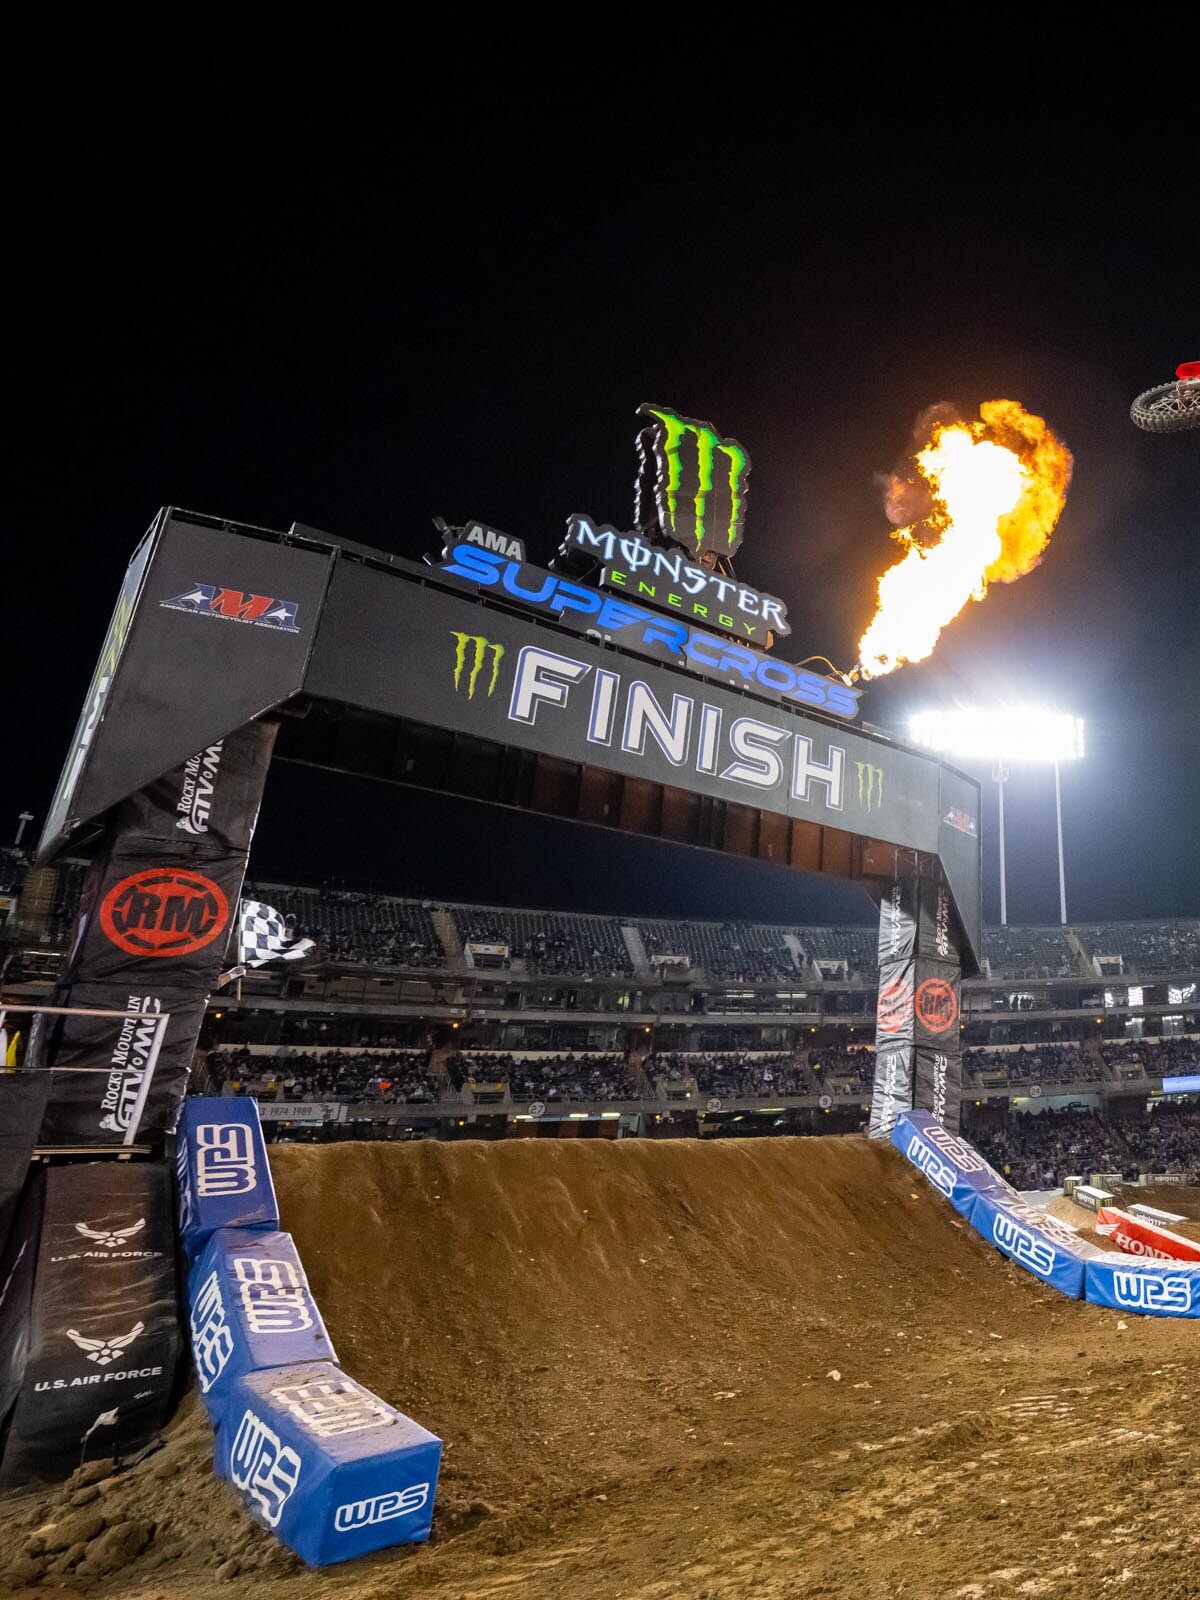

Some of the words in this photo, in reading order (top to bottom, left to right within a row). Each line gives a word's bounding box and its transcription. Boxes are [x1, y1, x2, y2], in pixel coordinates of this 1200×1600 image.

[466, 524, 523, 561] AMA
[576, 519, 788, 631] MONSTER
[159, 582, 301, 630] AMA
[159, 603, 199, 614] AMERICAN
[199, 610, 253, 625] MOTORCYCLIST
[254, 621, 300, 634] ASSOCIATION
[610, 569, 757, 636] ENERGY
[440, 543, 860, 716] SUPERCROSS
[508, 645, 847, 811] FINISH
[176, 777, 196, 815] ROCKY
[270, 1107, 289, 1116] 1974
[293, 1106, 312, 1116] 1989
[531, 1104, 544, 1115] 27
[709, 1101, 720, 1109] 34
[196, 1123, 257, 1197] WPS
[906, 1135, 958, 1198] WPS
[923, 1126, 984, 1173] WPS
[111, 1250, 163, 1258] FORCE
[992, 1212, 1056, 1277] WPS
[233, 1258, 314, 1335] WPS
[1113, 1271, 1192, 1313] WPS
[34, 1378, 69, 1392] U.S.
[70, 1374, 101, 1386] AIR
[103, 1366, 163, 1383] FORCE
[230, 1409, 302, 1528] WPS
[333, 1482, 430, 1532] WPS
